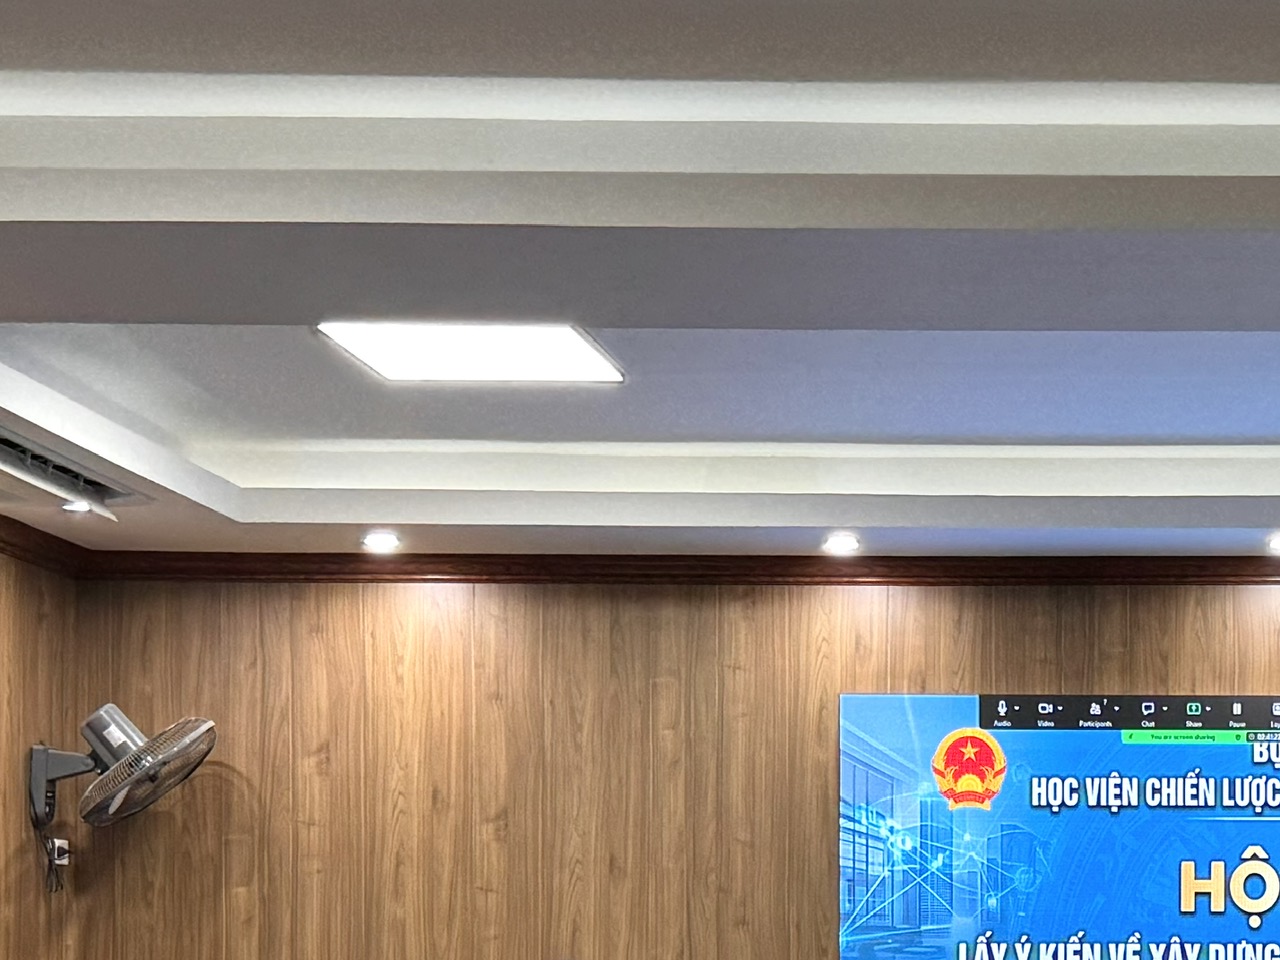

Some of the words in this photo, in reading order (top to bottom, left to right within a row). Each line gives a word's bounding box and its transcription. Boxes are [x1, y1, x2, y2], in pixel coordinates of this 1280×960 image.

[1079, 720, 1112, 729] Participants
[1141, 720, 1155, 728] Chat
[1185, 720, 1203, 728] Share
[1031, 776, 1079, 813] HỌC
[1085, 771, 1139, 813] VIỆN
[1145, 768, 1216, 807] CHIẾN
